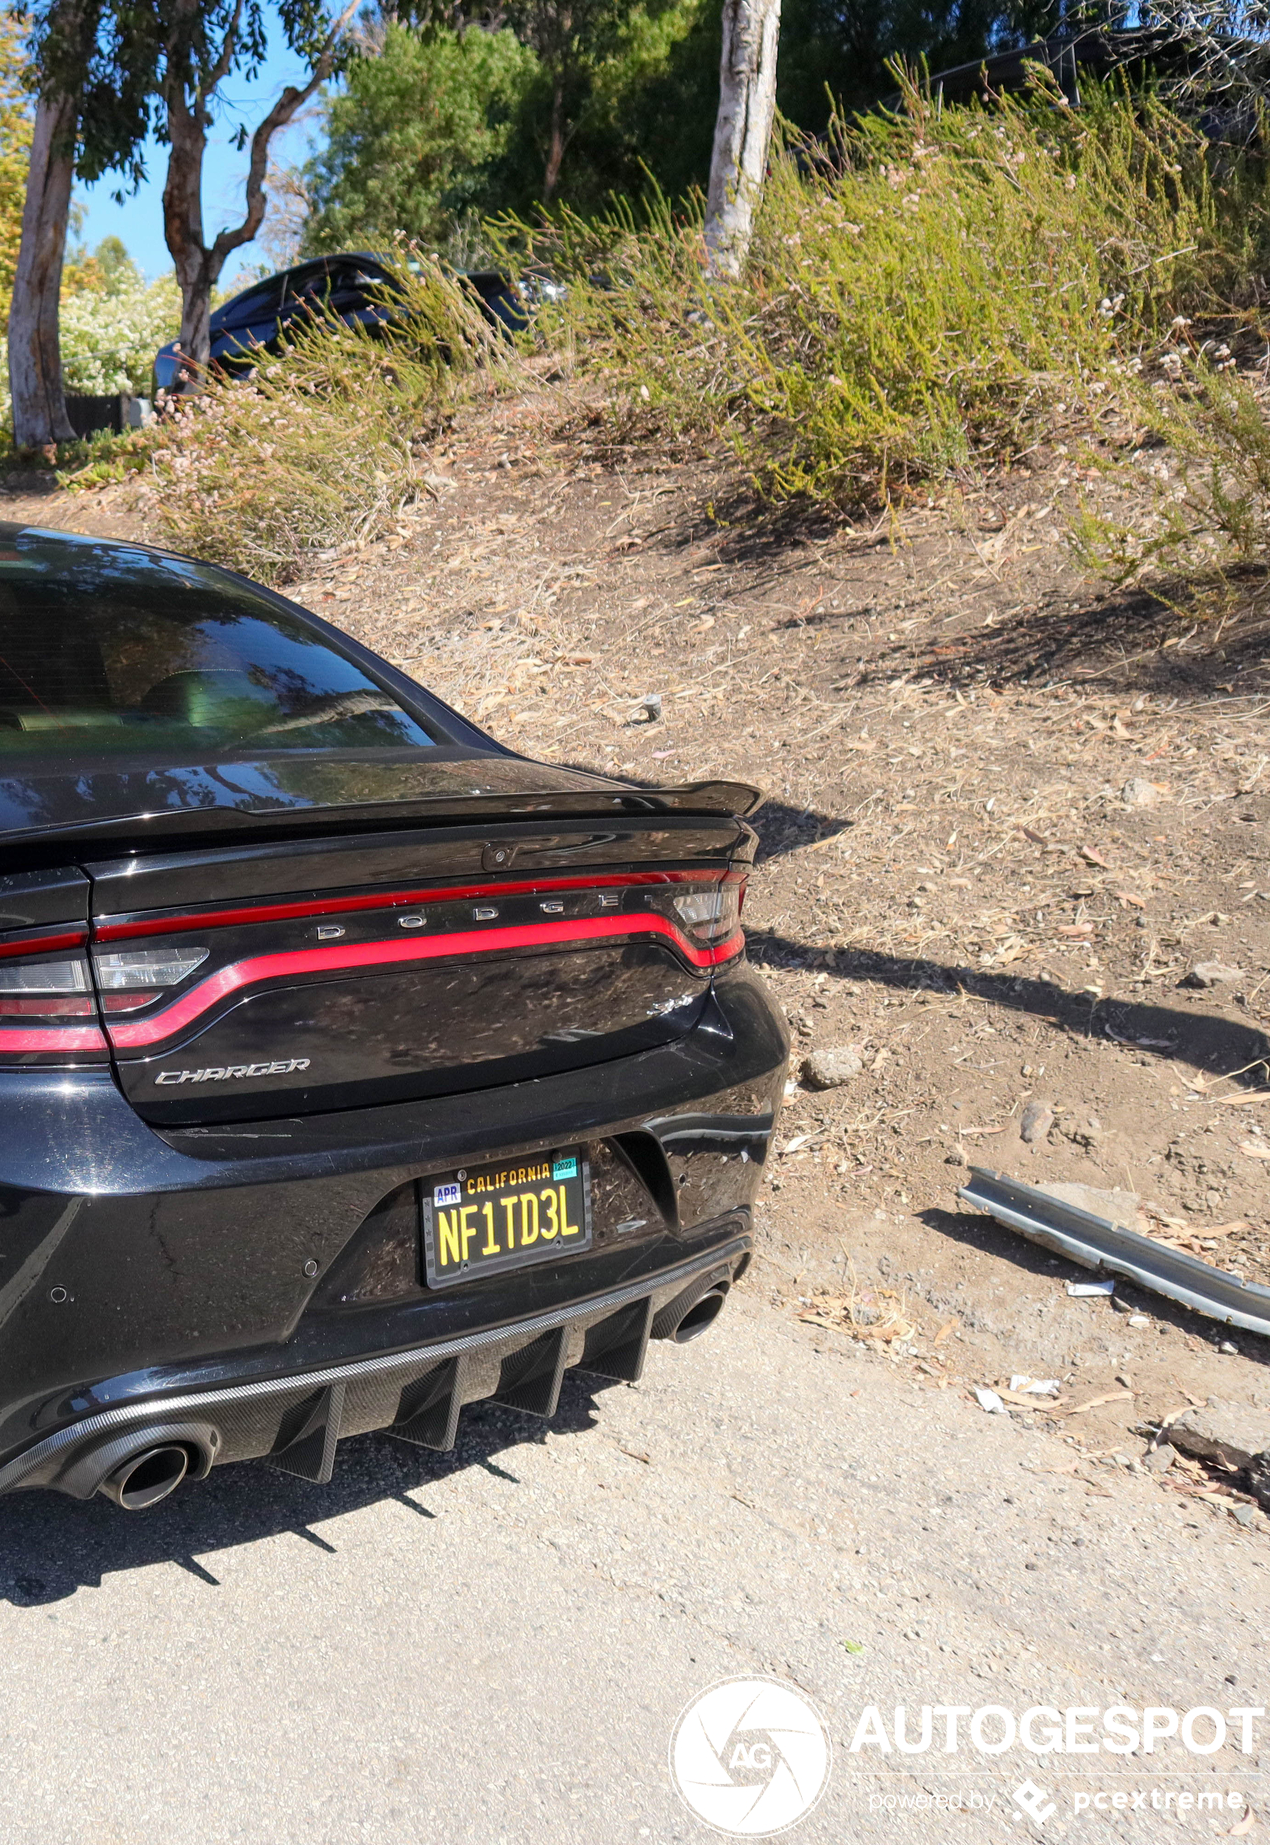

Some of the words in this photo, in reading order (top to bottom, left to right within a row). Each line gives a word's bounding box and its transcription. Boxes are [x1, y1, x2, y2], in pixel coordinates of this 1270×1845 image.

[316, 894, 619, 940] DODGE
[154, 1058, 311, 1085] CHARGER
[467, 1163, 551, 1194] CALIFORNIA
[557, 1160, 573, 1171] 2022
[437, 1186, 458, 1204] APR
[438, 1185, 579, 1266] NF1TD3L
